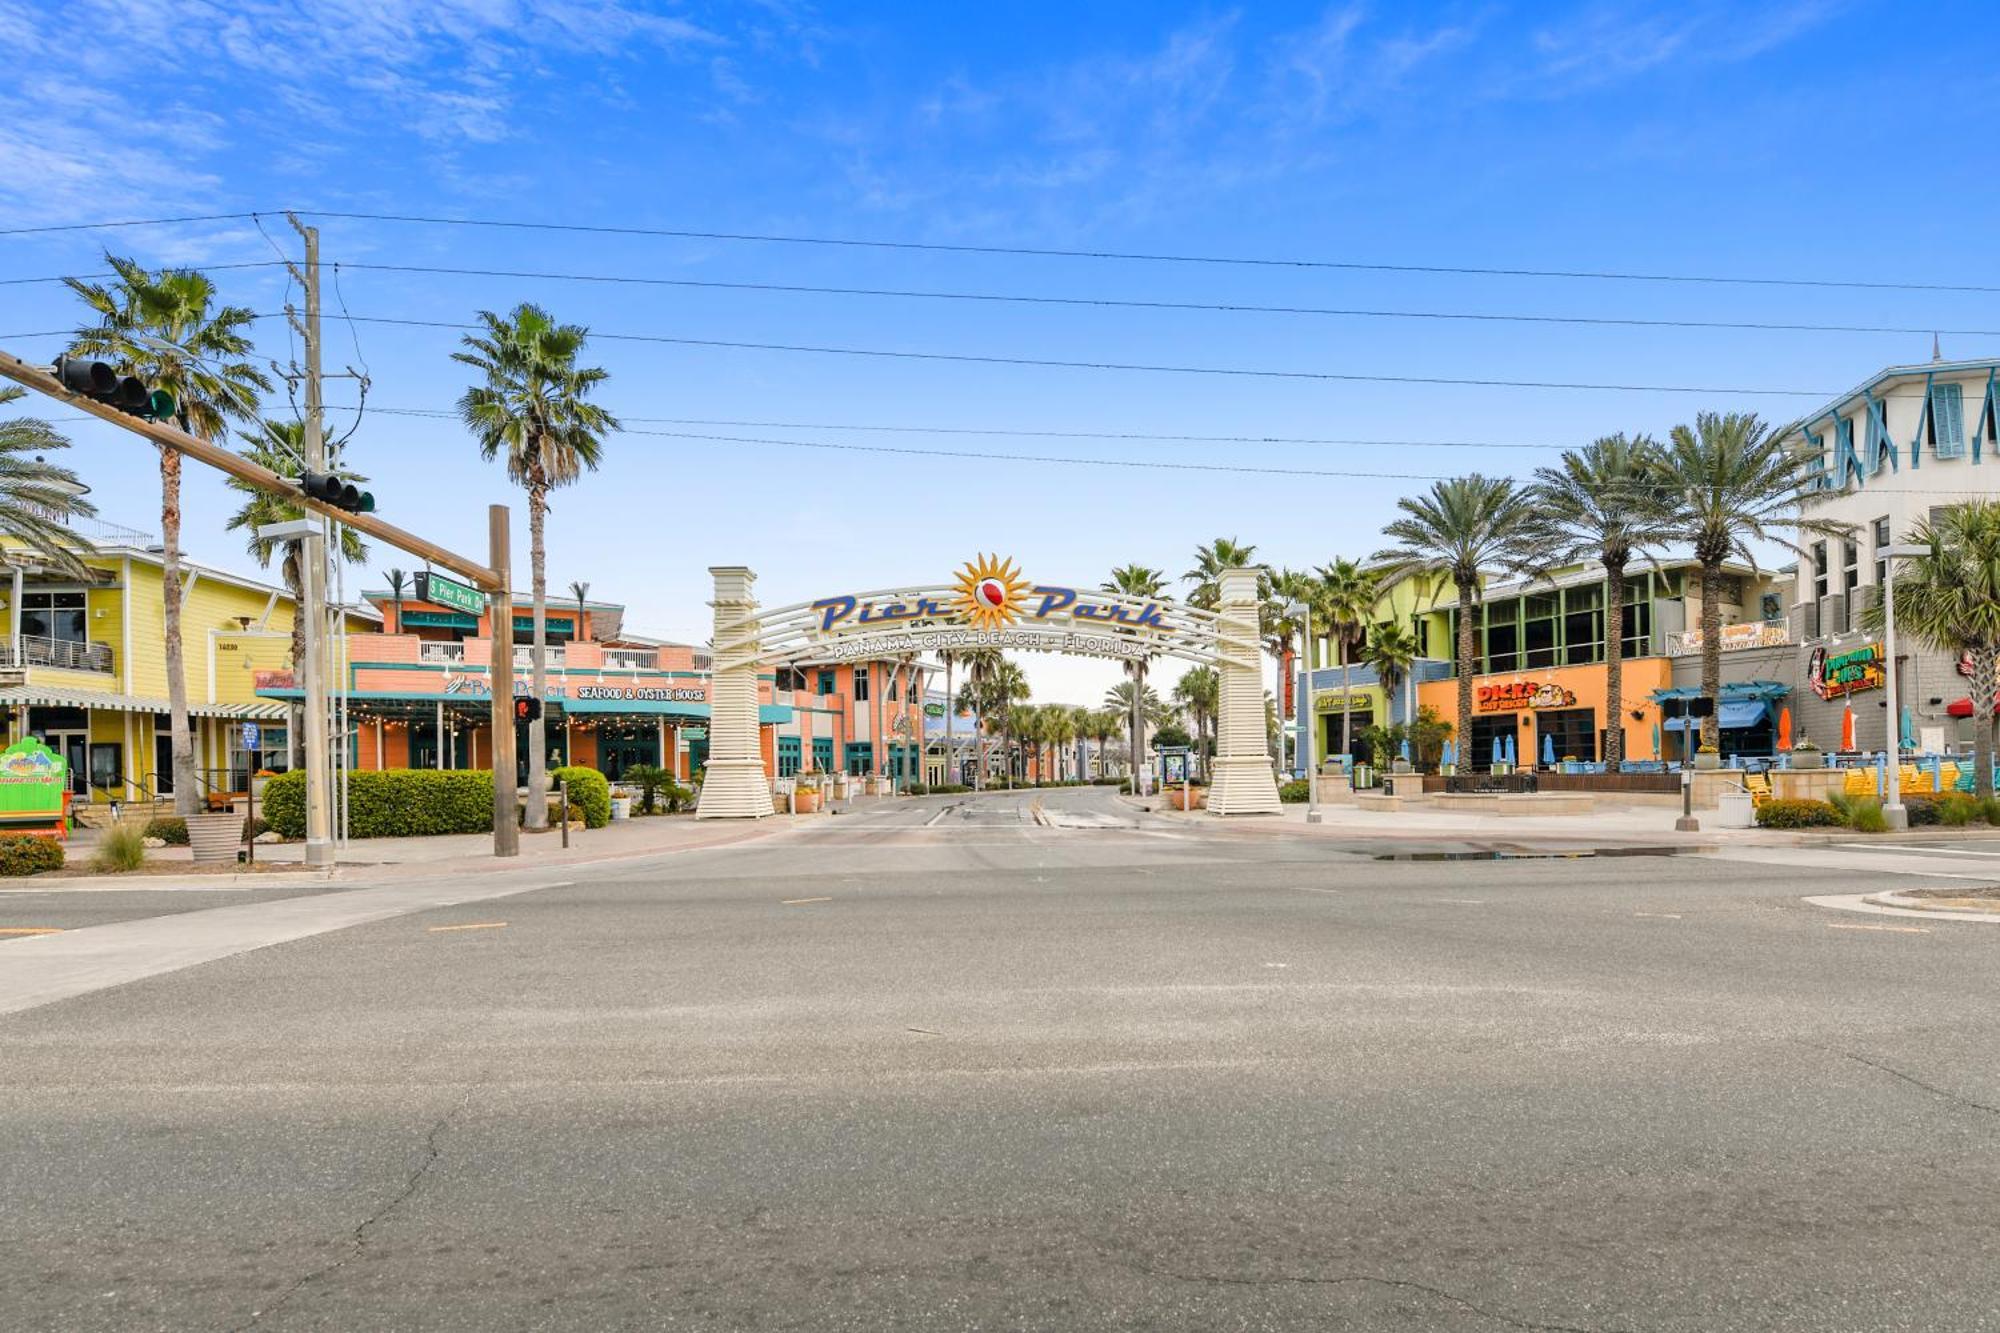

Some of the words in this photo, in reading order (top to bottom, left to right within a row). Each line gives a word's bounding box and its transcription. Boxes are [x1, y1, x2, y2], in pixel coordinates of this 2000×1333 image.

[430, 580, 436, 594] S
[439, 583, 454, 601] Pier
[456, 588, 473, 607] Park
[811, 594, 954, 632] Pier
[1031, 586, 1177, 632] Park
[833, 633, 913, 659] PANAMA
[922, 632, 968, 647] CITY
[977, 631, 1041, 646] BEACH
[1062, 636, 1146, 658] FLORIDA
[578, 687, 622, 700] SEAFOOD
[624, 688, 634, 700] &
[636, 688, 673, 701] OYSTER
[674, 689, 706, 701] HOUSE
[1478, 683, 1538, 702] DICK'S
